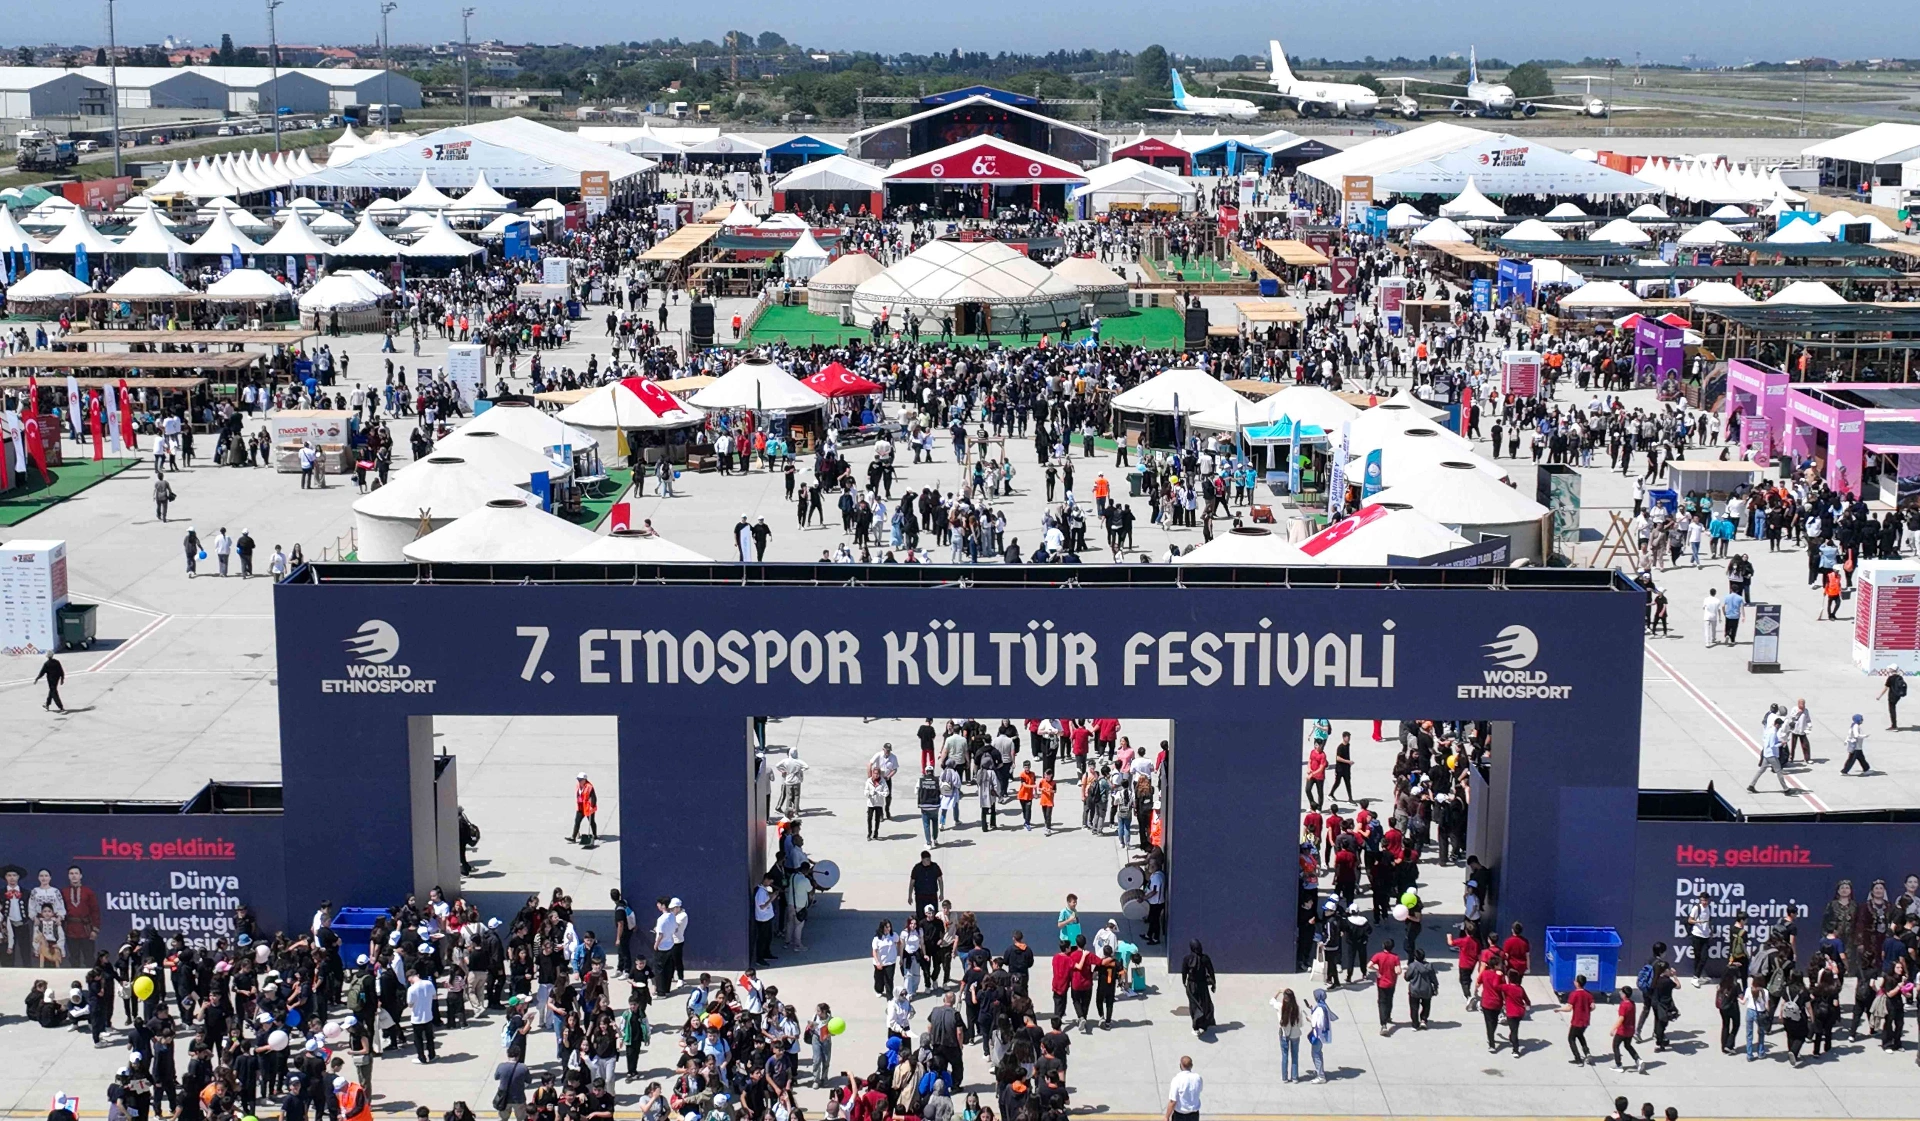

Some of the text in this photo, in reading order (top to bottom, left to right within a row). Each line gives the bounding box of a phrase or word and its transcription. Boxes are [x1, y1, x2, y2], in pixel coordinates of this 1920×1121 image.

[516, 617, 1397, 688] 7. ETNOSPOR KÜLTÜR FESTİVALİ
[346, 665, 411, 679] WORLD
[1483, 670, 1548, 684] WORLD
[321, 679, 437, 693] ETHNOSPORT
[1457, 685, 1573, 699] ETHNOSPORT
[101, 838, 236, 860] Hoş geldiniz
[1676, 845, 1811, 867] Hoş geldiniz
[170, 871, 239, 893] Dünya
[1676, 878, 1745, 900] Dünya
[106, 891, 240, 910] kültürlerinin
